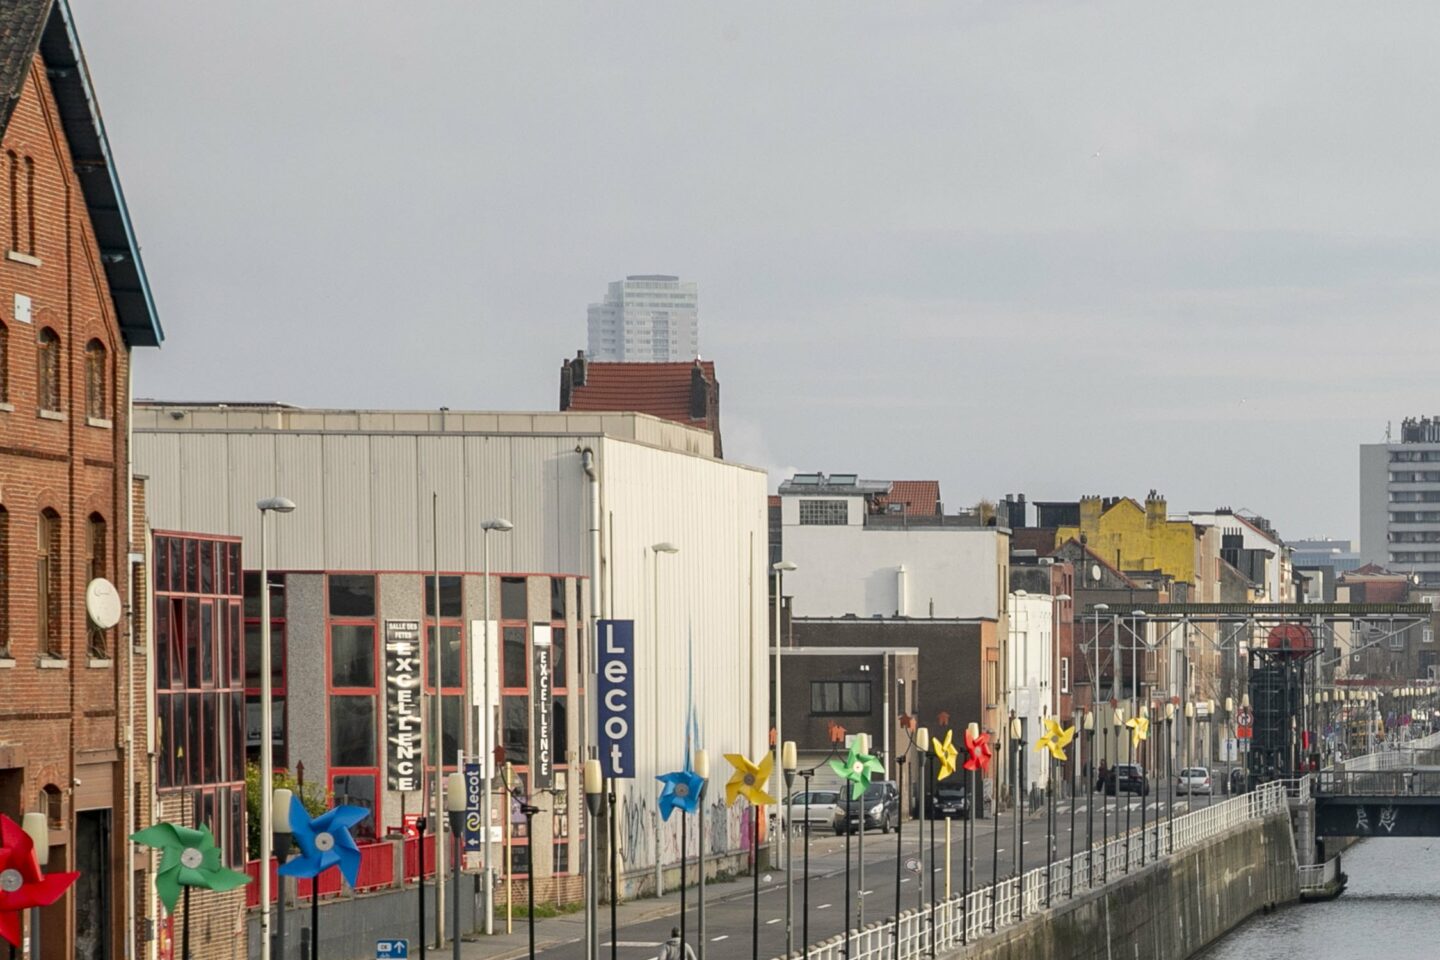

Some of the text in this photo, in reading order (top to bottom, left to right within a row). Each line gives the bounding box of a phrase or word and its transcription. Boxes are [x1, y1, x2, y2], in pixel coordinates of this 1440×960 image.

[395, 642, 414, 791] EXCELLENCE
[540, 651, 549, 776] EXCELLENCE
[604, 624, 628, 774] Lecot
[467, 770, 480, 810] Lecot
